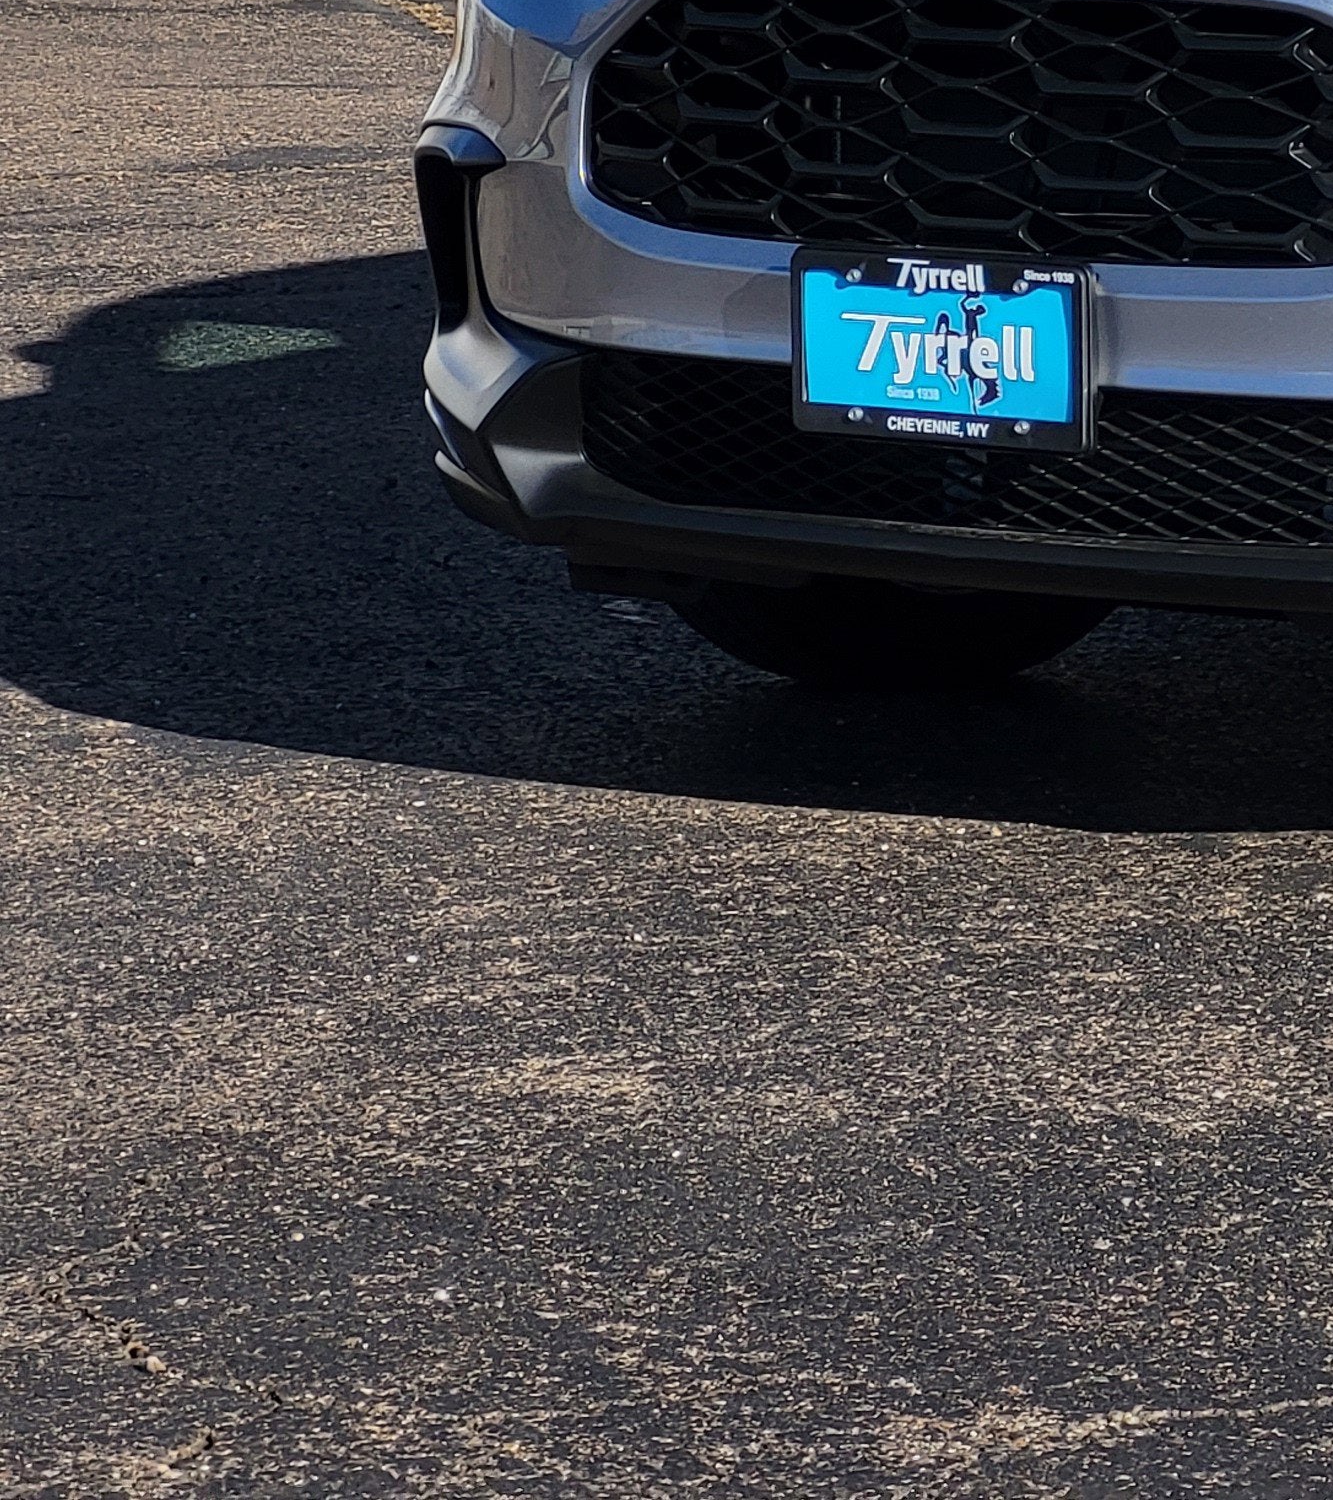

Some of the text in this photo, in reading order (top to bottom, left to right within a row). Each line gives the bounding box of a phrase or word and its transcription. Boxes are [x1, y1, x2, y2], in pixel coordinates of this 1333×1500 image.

[887, 257, 985, 293] Tyrrell
[1023, 269, 1050, 282] Since
[841, 312, 1035, 384] Tyrrell
[887, 415, 990, 438] CHEYENNE, WY
